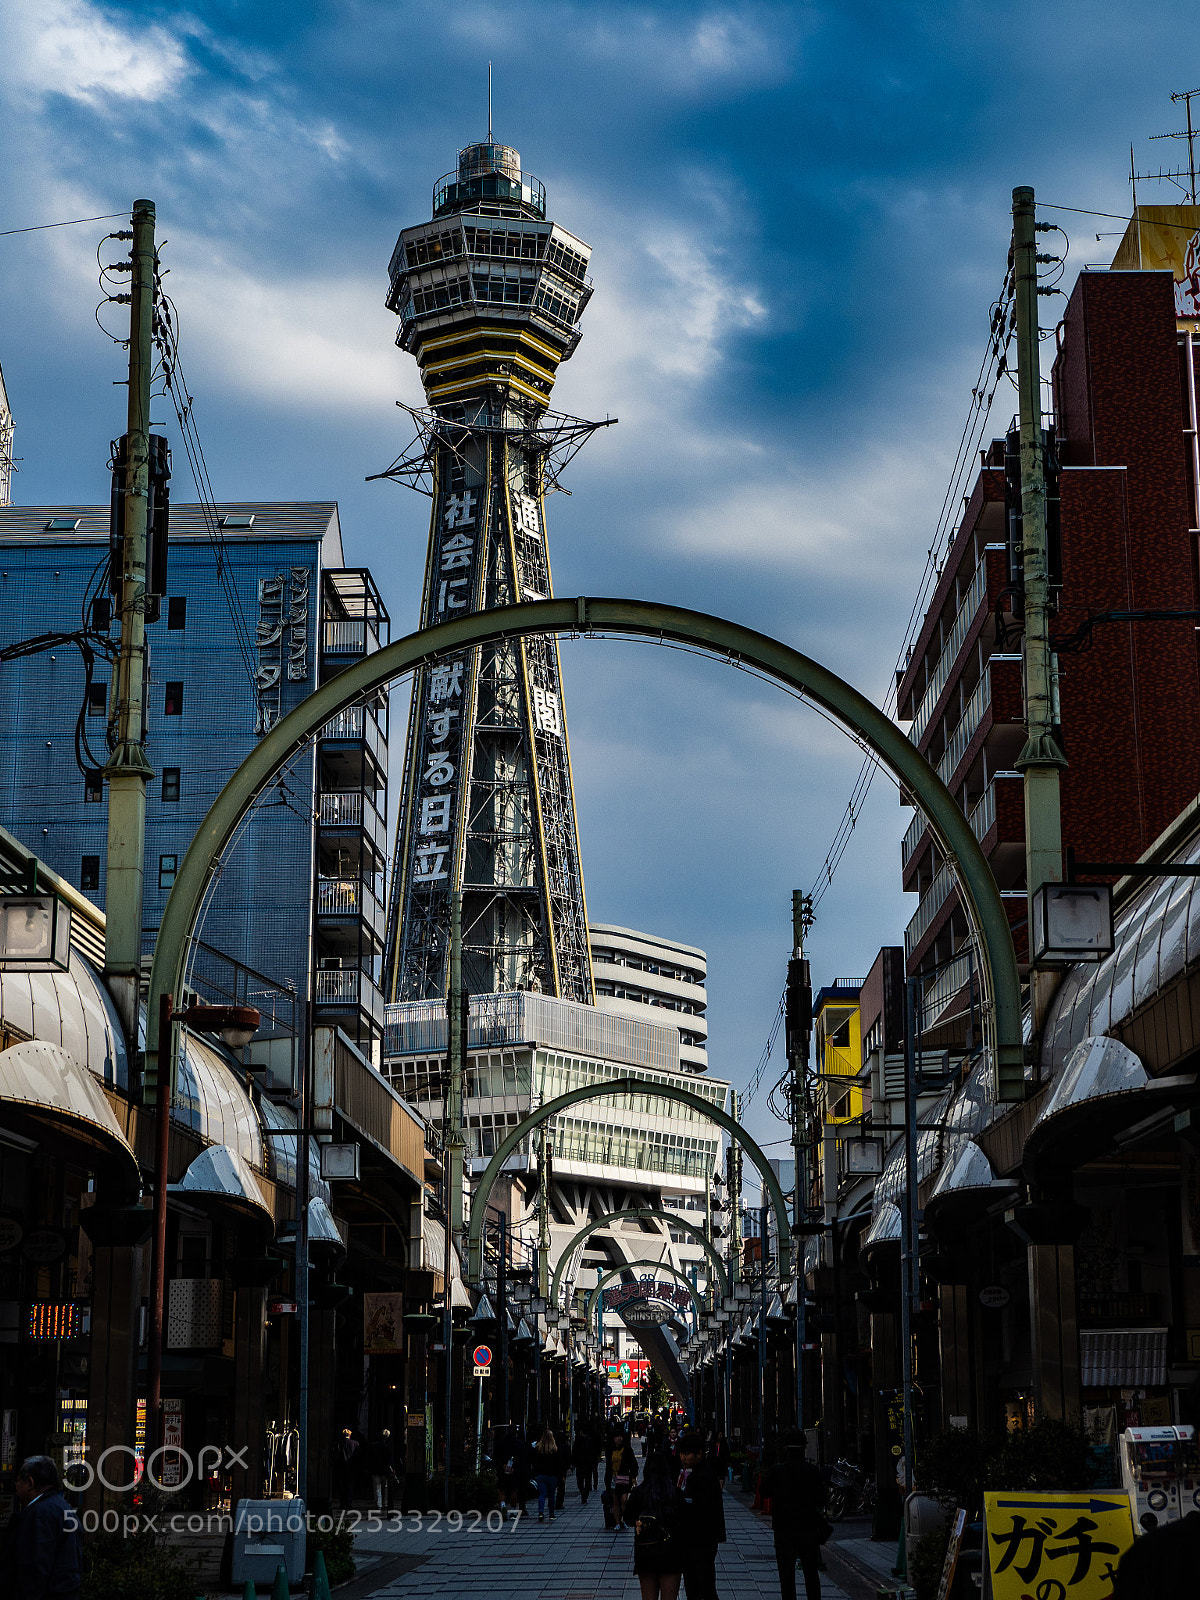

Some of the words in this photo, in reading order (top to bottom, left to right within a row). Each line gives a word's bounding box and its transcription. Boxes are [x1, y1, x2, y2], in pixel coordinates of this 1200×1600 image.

[414, 492, 478, 884] 社会に献する日立
[513, 492, 562, 737] 通閣
